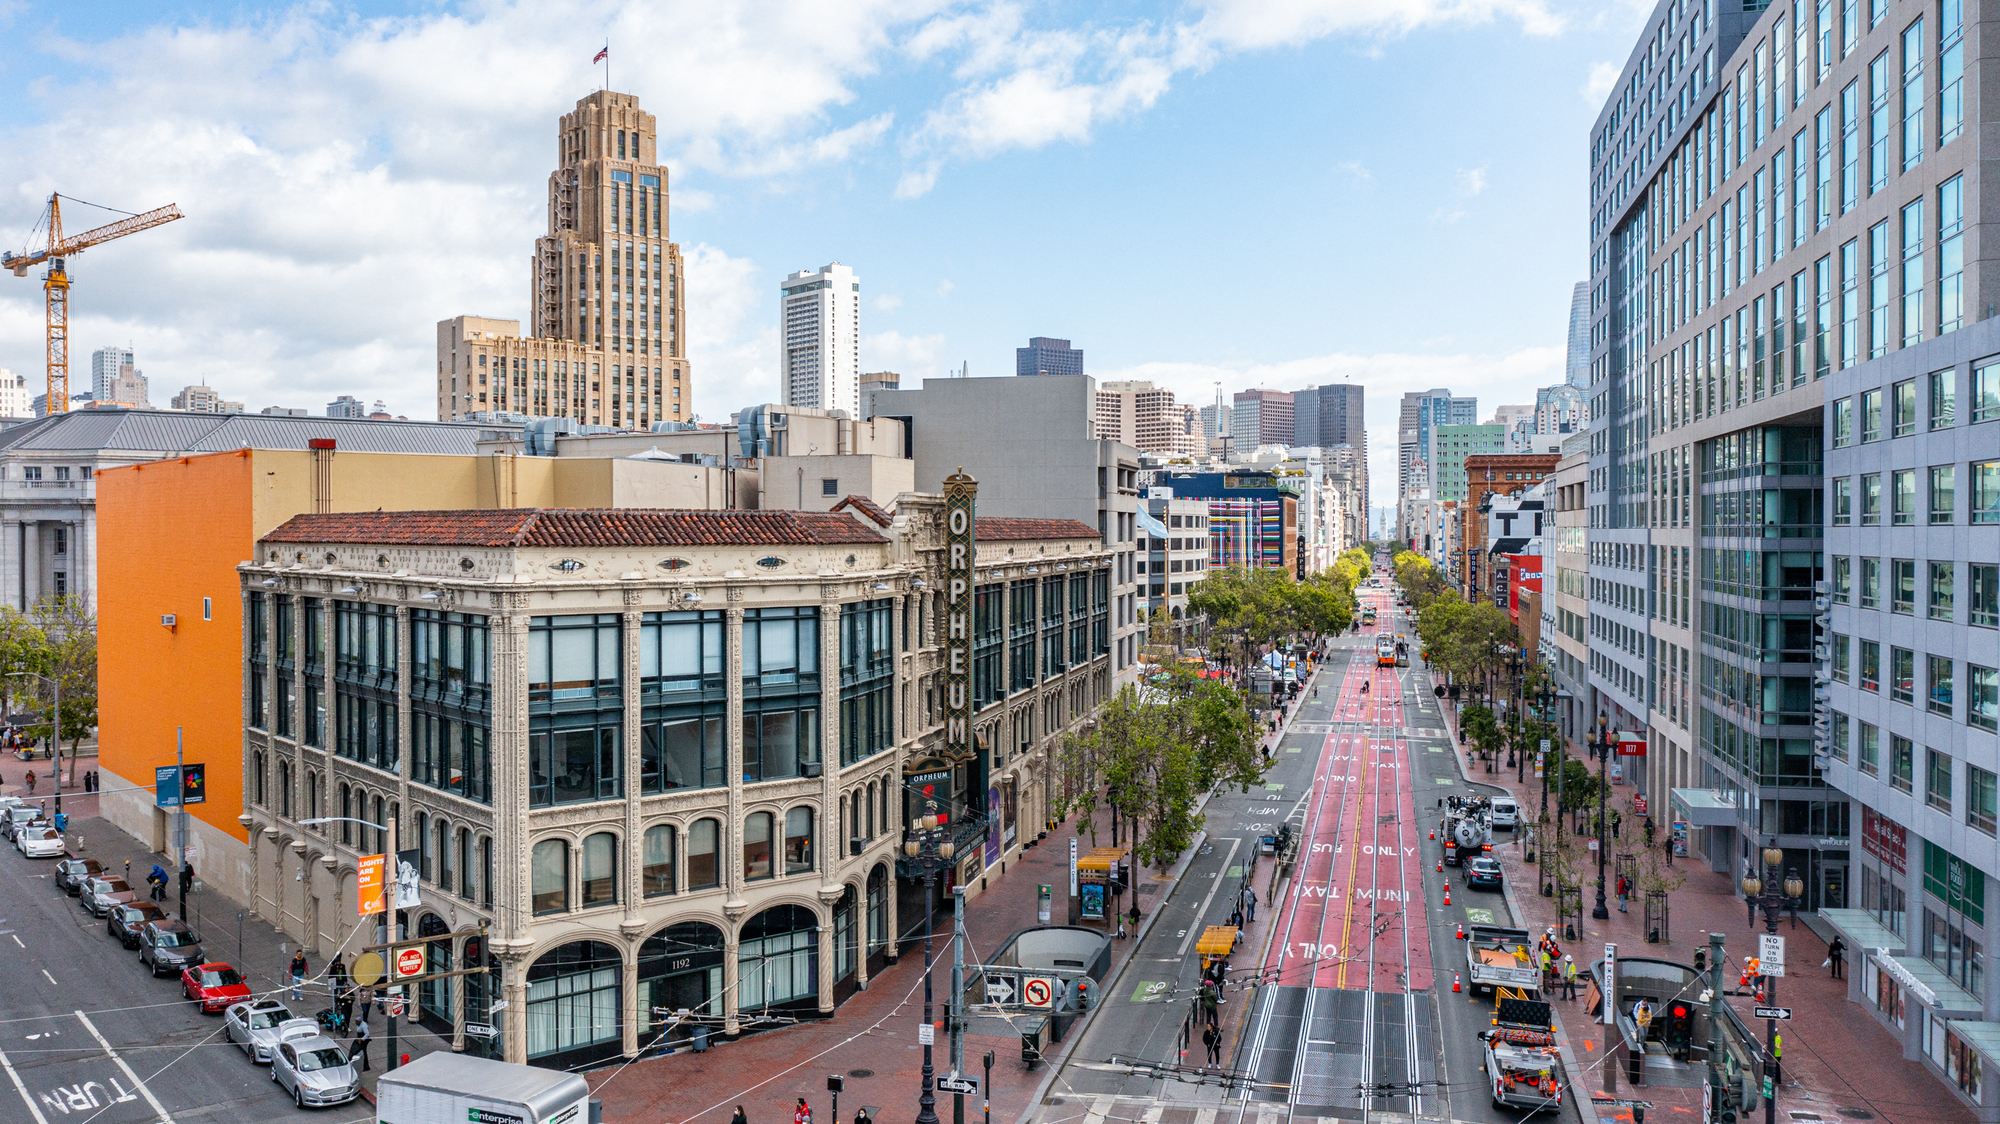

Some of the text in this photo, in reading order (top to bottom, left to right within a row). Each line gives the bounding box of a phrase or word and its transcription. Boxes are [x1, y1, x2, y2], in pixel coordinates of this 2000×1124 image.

[948, 508, 967, 744] ORPHEUM
[914, 772, 948, 782] ORPHEUM
[1363, 846, 1415, 856] ONLY
[360, 858, 384, 867] LIGHTS
[1293, 886, 1340, 898] TAXI
[1279, 943, 1337, 959] ONLY
[673, 958, 690, 970] 1192
[37, 1078, 137, 1116] TURN
[472, 1112, 522, 1124] enterprise
